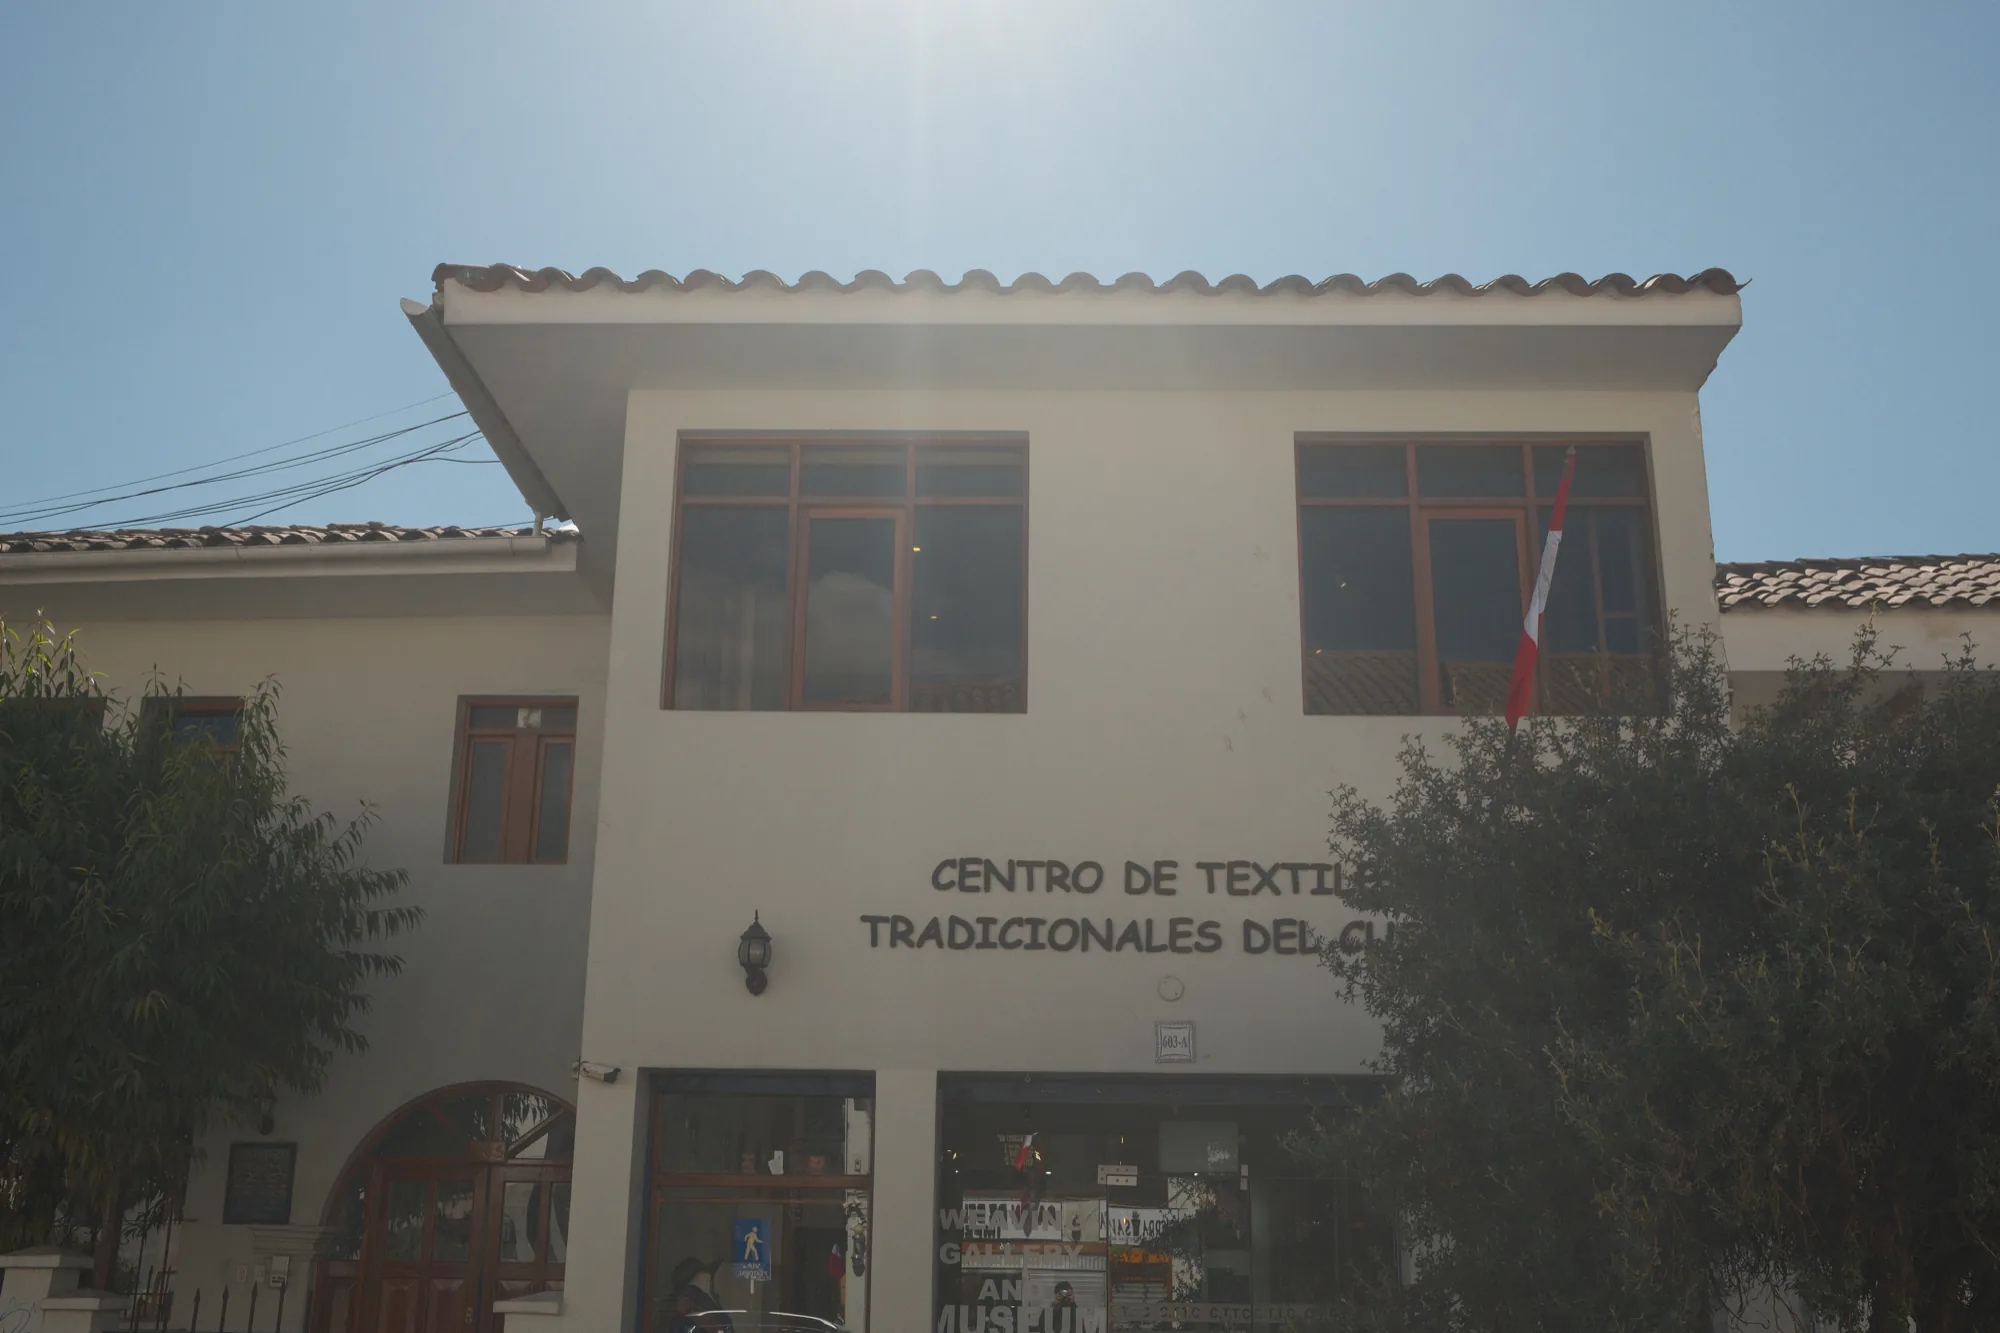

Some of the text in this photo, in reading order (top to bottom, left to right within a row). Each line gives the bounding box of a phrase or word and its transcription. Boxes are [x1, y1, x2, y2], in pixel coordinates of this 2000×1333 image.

[931, 857, 1104, 893] CENTRO
[1124, 860, 1178, 895] DE
[860, 914, 1222, 954] TRADICIONALES
[1243, 918, 1322, 955] DEL
[939, 1242, 1084, 1267] GALLERY
